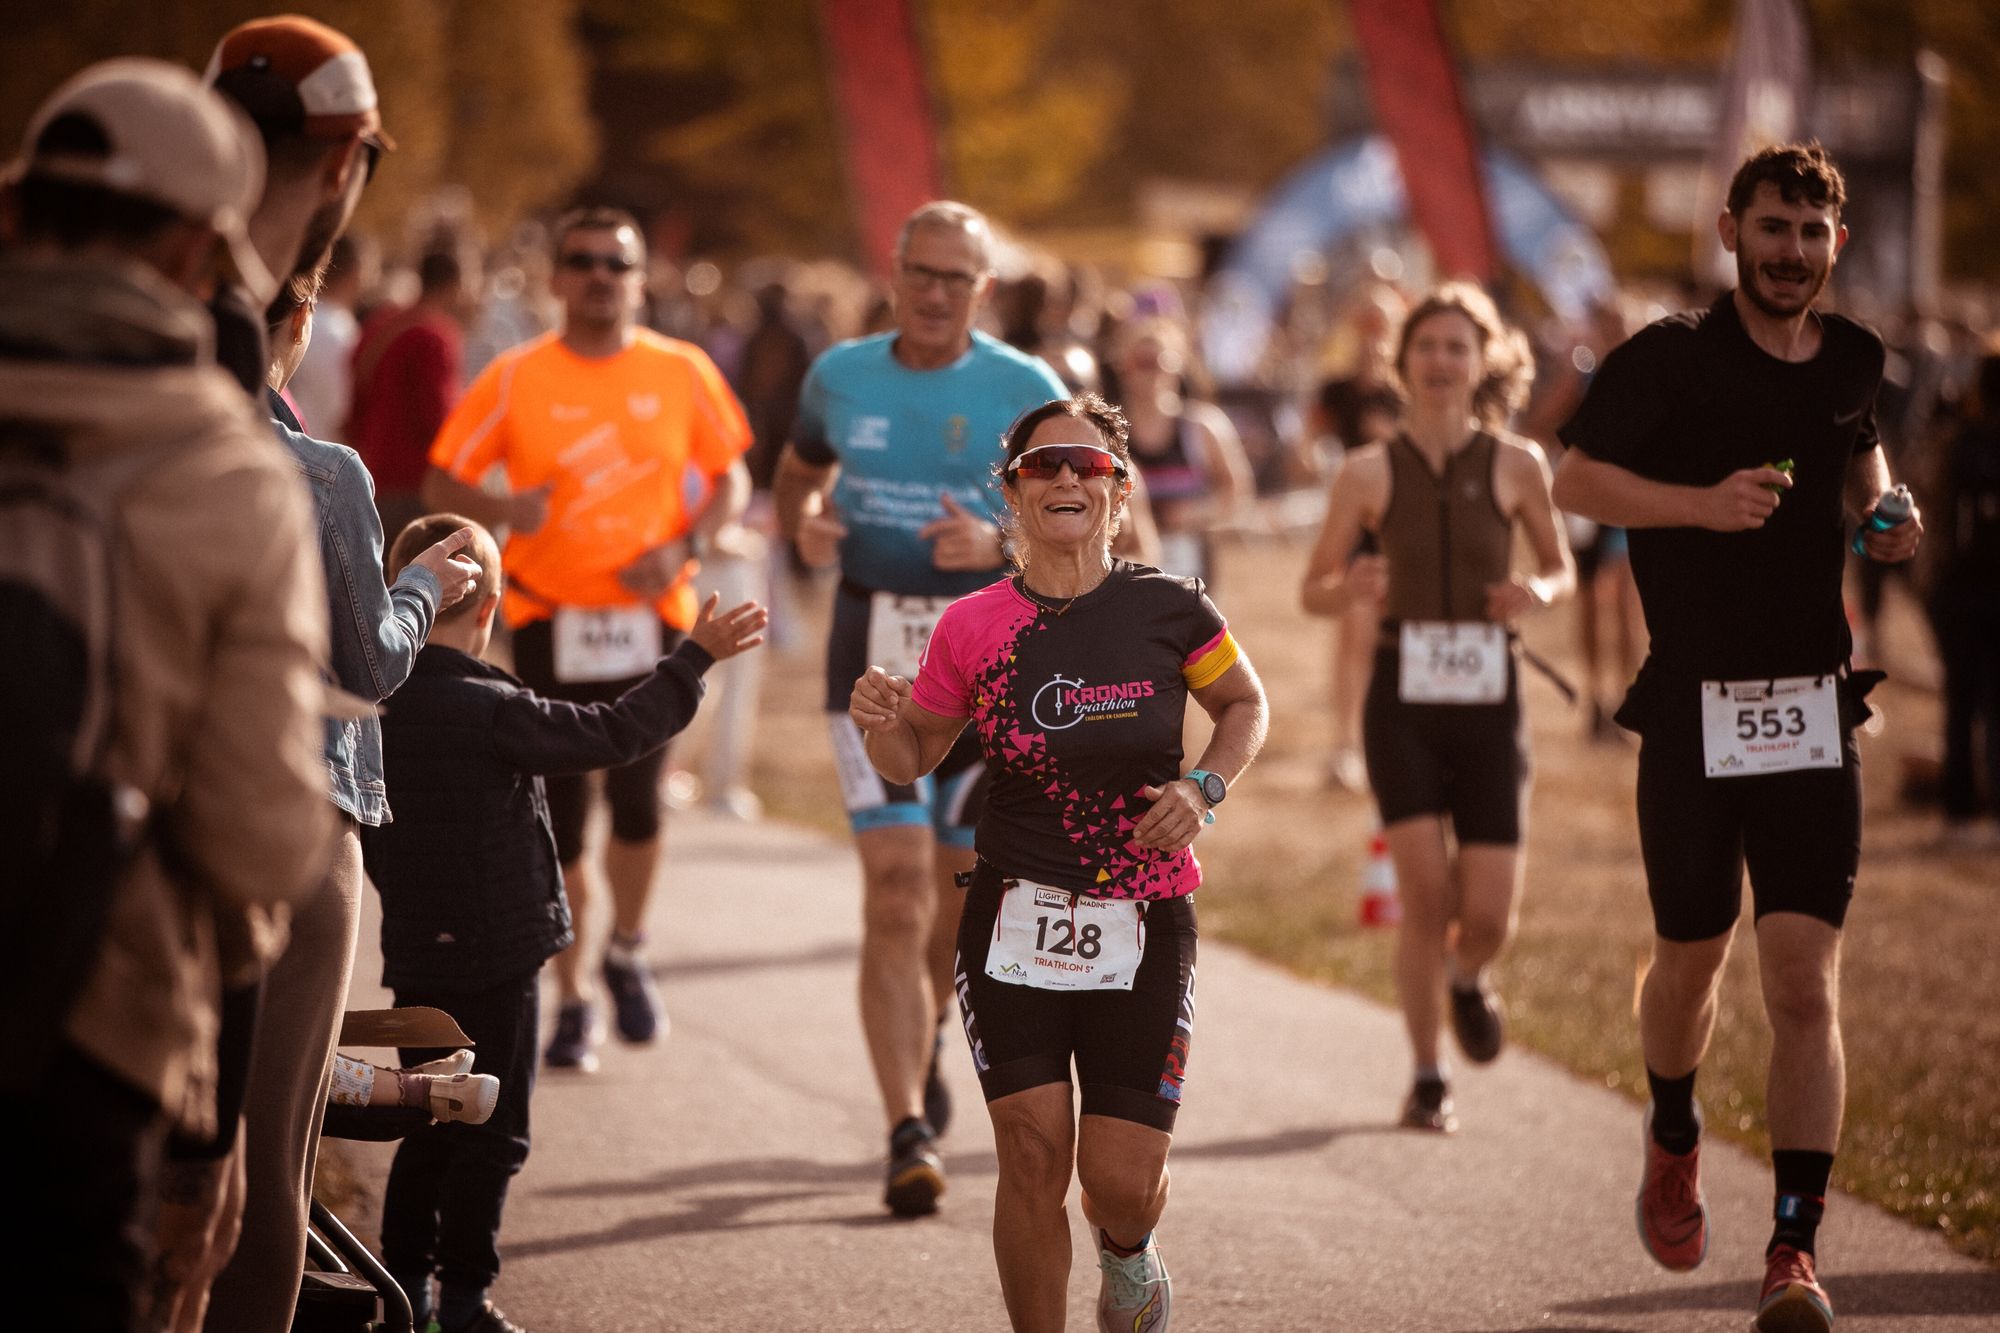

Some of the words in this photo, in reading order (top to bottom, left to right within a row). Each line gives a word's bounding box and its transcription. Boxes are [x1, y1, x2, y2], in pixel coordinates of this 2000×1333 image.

[1065, 681, 1155, 705] KRONOS
[1073, 697, 1136, 714] triathlon
[1737, 706, 1806, 740] 553
[1038, 892, 1061, 902] LIGHT
[1036, 916, 1102, 960] 128
[1034, 957, 1083, 972] TRIATHLON
